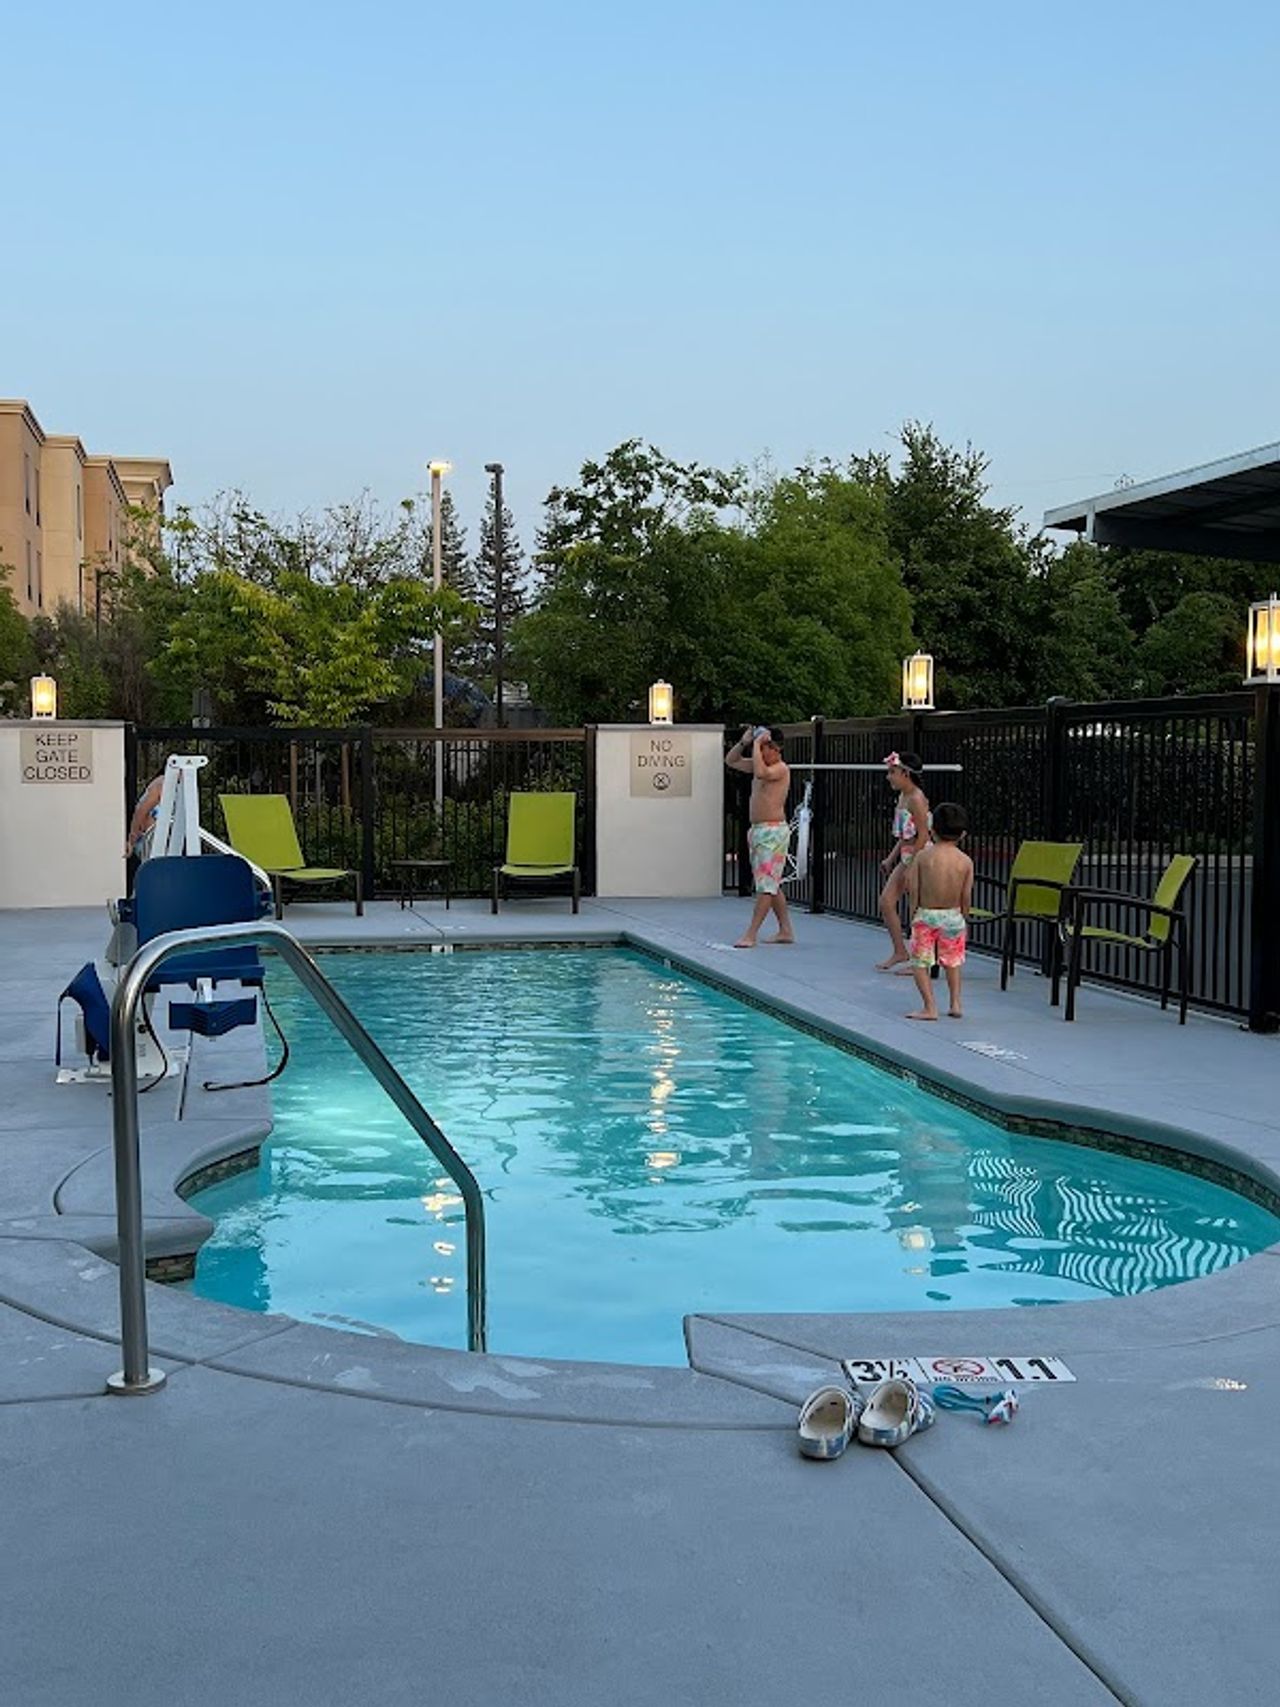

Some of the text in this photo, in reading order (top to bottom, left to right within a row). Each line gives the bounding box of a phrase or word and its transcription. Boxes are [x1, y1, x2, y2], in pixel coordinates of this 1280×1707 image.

[36, 733, 78, 746] KEEP
[650, 739, 673, 752] NO
[36, 748, 79, 763] GATE
[637, 754, 686, 768] DIVING
[23, 766, 91, 780] CLOSED
